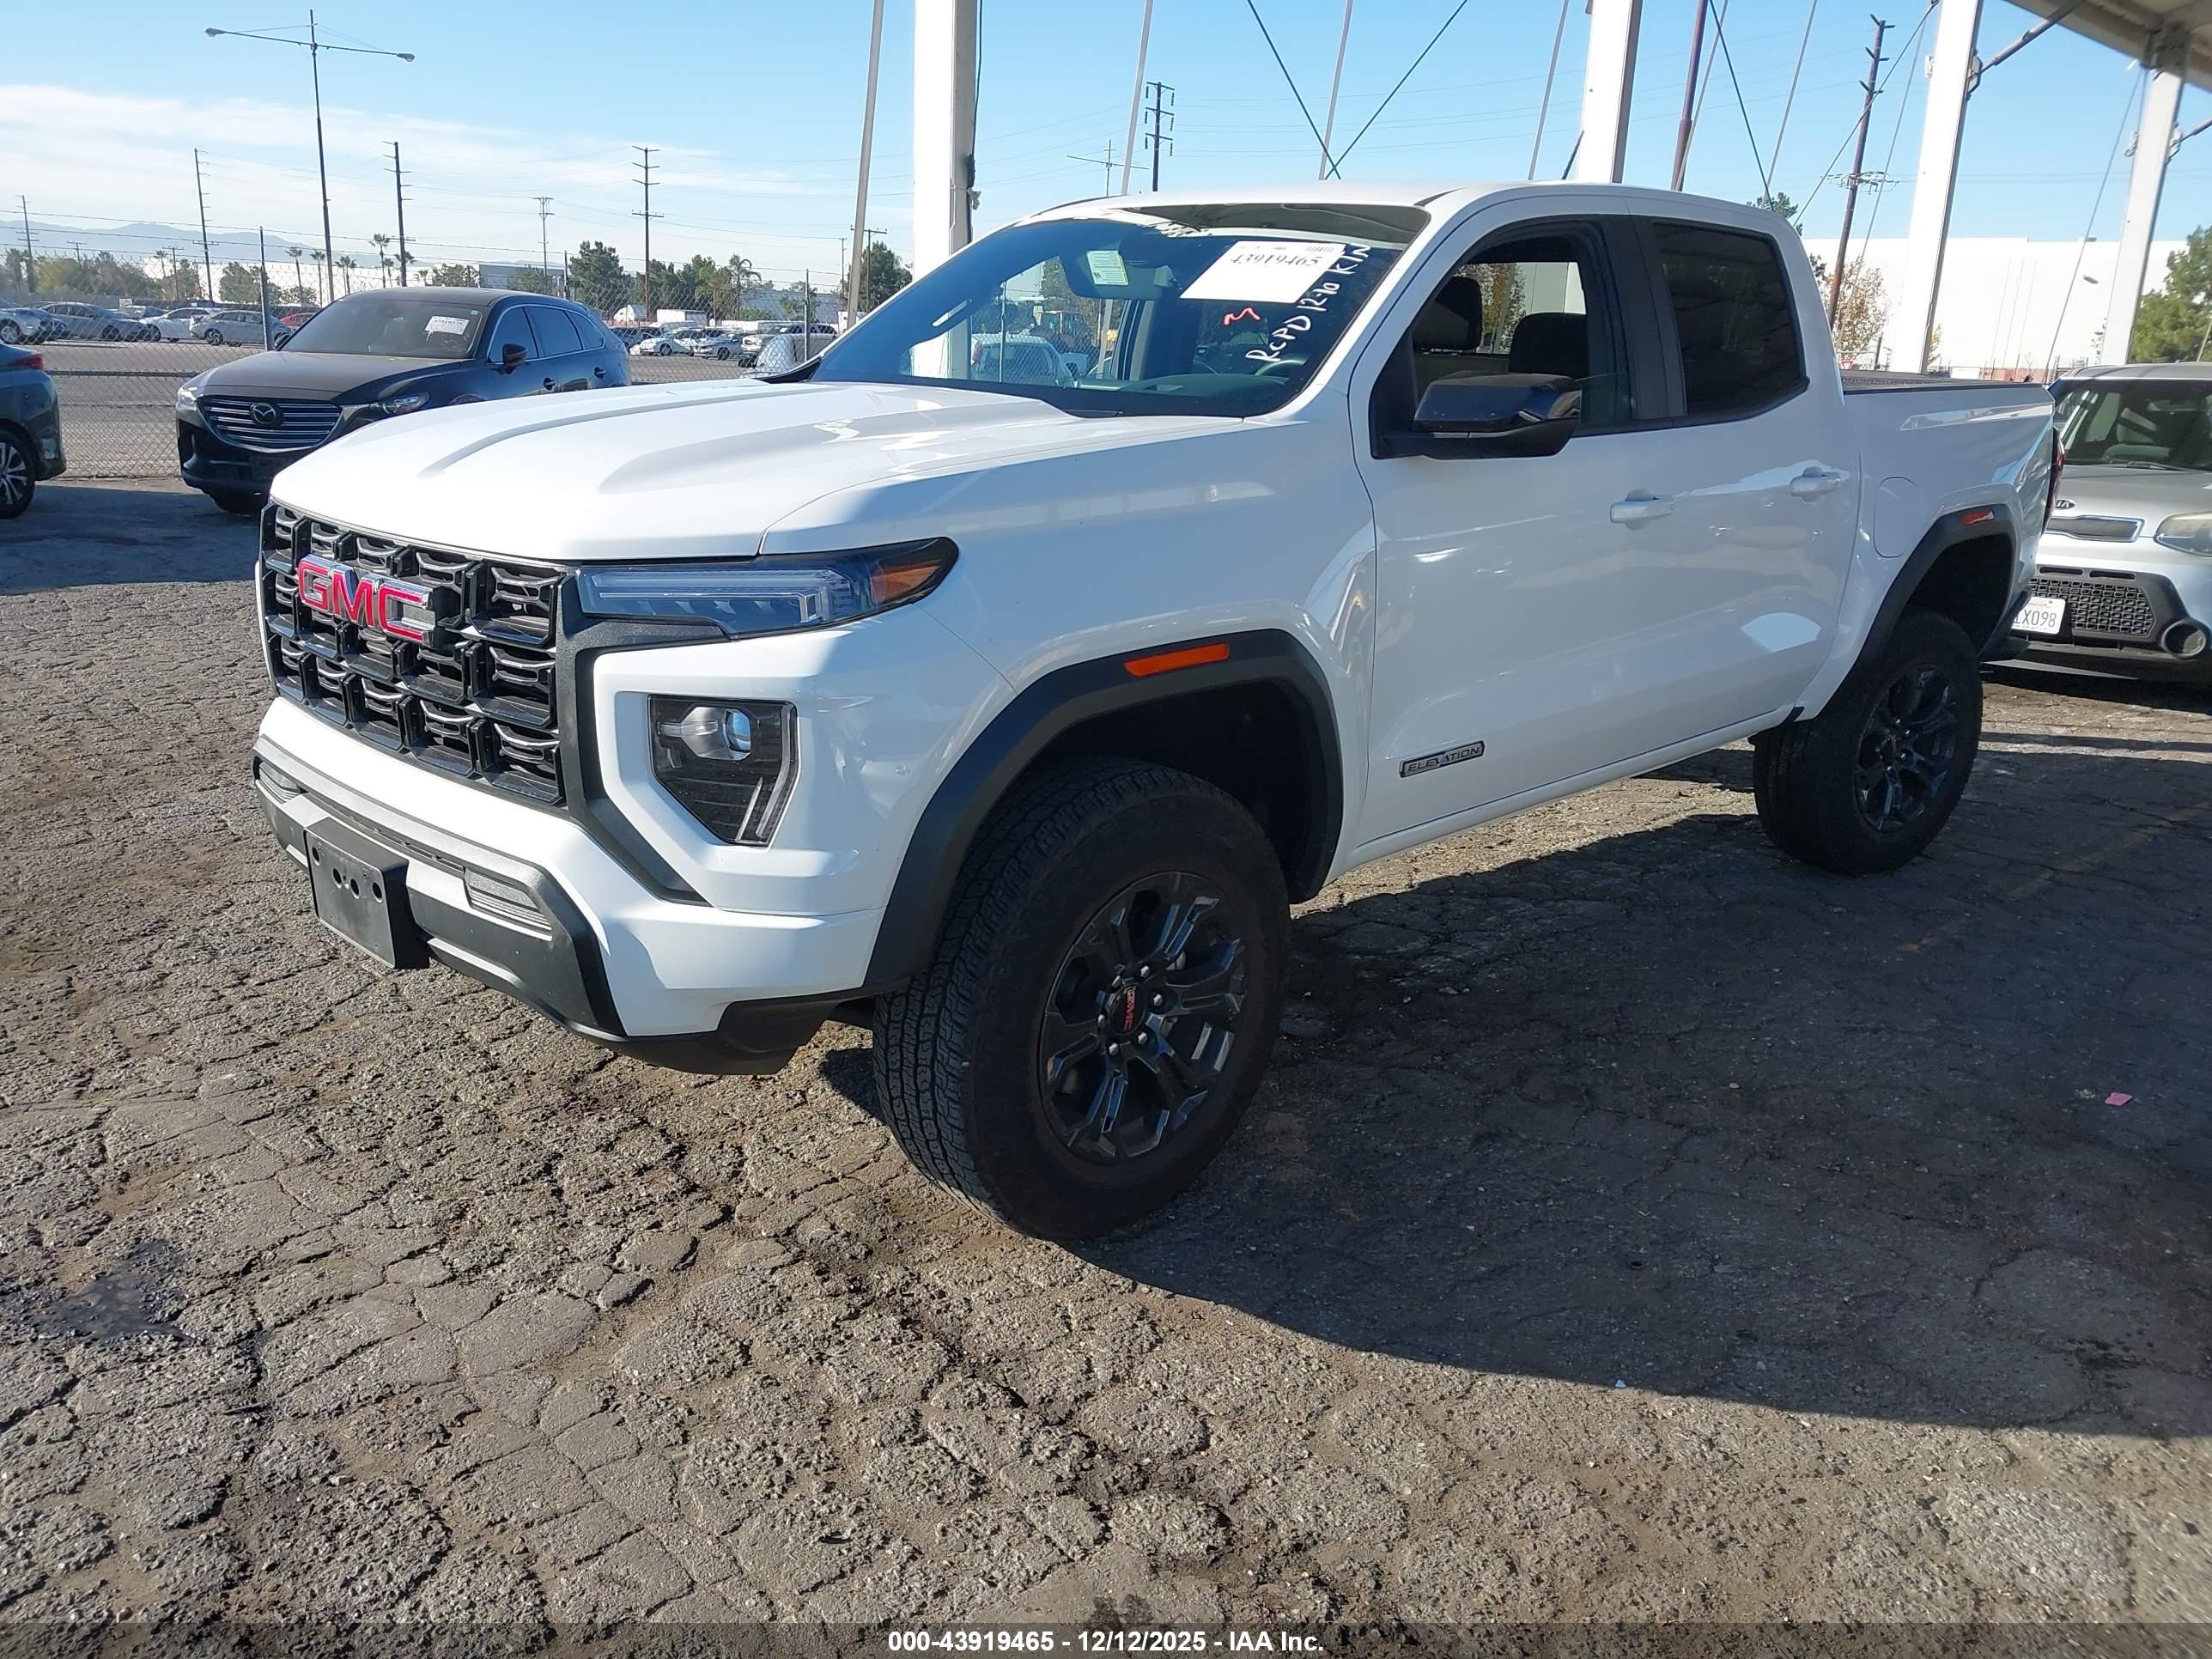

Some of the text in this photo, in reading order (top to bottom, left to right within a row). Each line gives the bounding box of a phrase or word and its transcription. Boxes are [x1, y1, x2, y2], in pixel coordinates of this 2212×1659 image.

[298, 555, 435, 648] GMC
[1407, 746, 1480, 772] ELEVATION
[1123, 988, 1136, 1031] GMC
